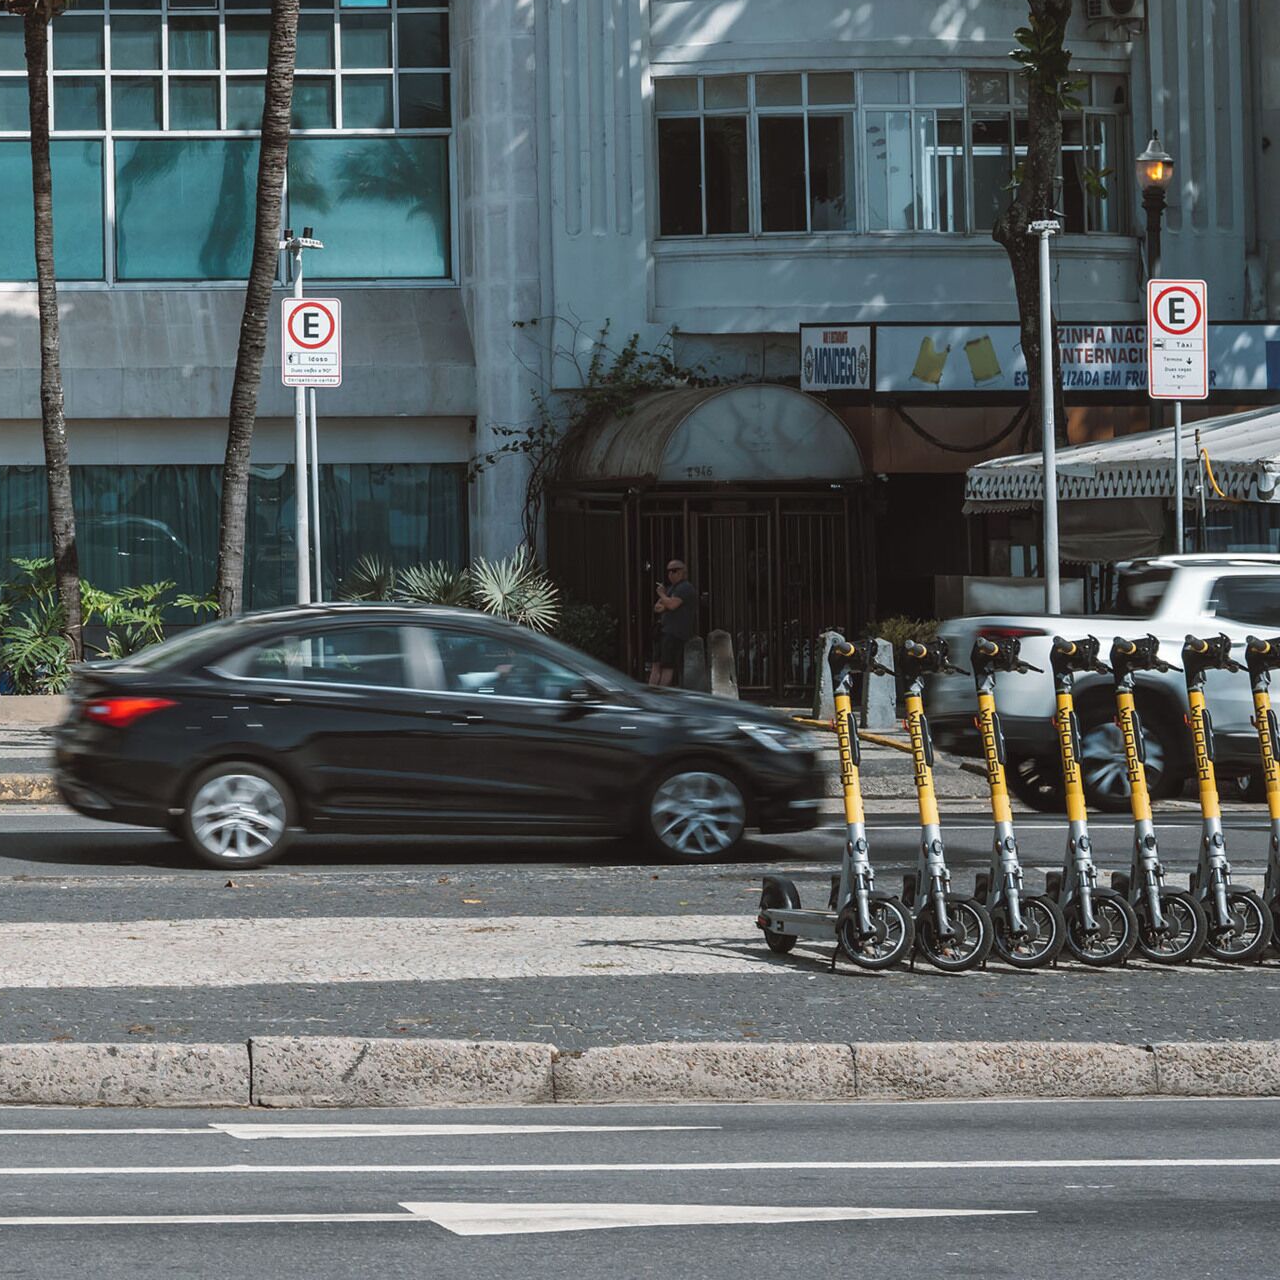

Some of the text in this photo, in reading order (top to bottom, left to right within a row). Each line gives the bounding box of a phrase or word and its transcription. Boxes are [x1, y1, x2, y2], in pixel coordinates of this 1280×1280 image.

[303, 313, 319, 338] E
[1057, 328, 1106, 344] ZINHA
[1168, 297, 1185, 324] E
[814, 347, 856, 385] MONDEGO
[1103, 370, 1120, 386] EM
[836, 708, 854, 786] WHOOSH
[908, 709, 929, 787] WHOOSH
[980, 708, 1001, 785] WHOOSH
[1058, 706, 1077, 784] WHOOSH
[1120, 706, 1141, 783] WHOOSH
[1191, 704, 1210, 781] WHOOSH
[1256, 704, 1278, 783] WHOOSH
